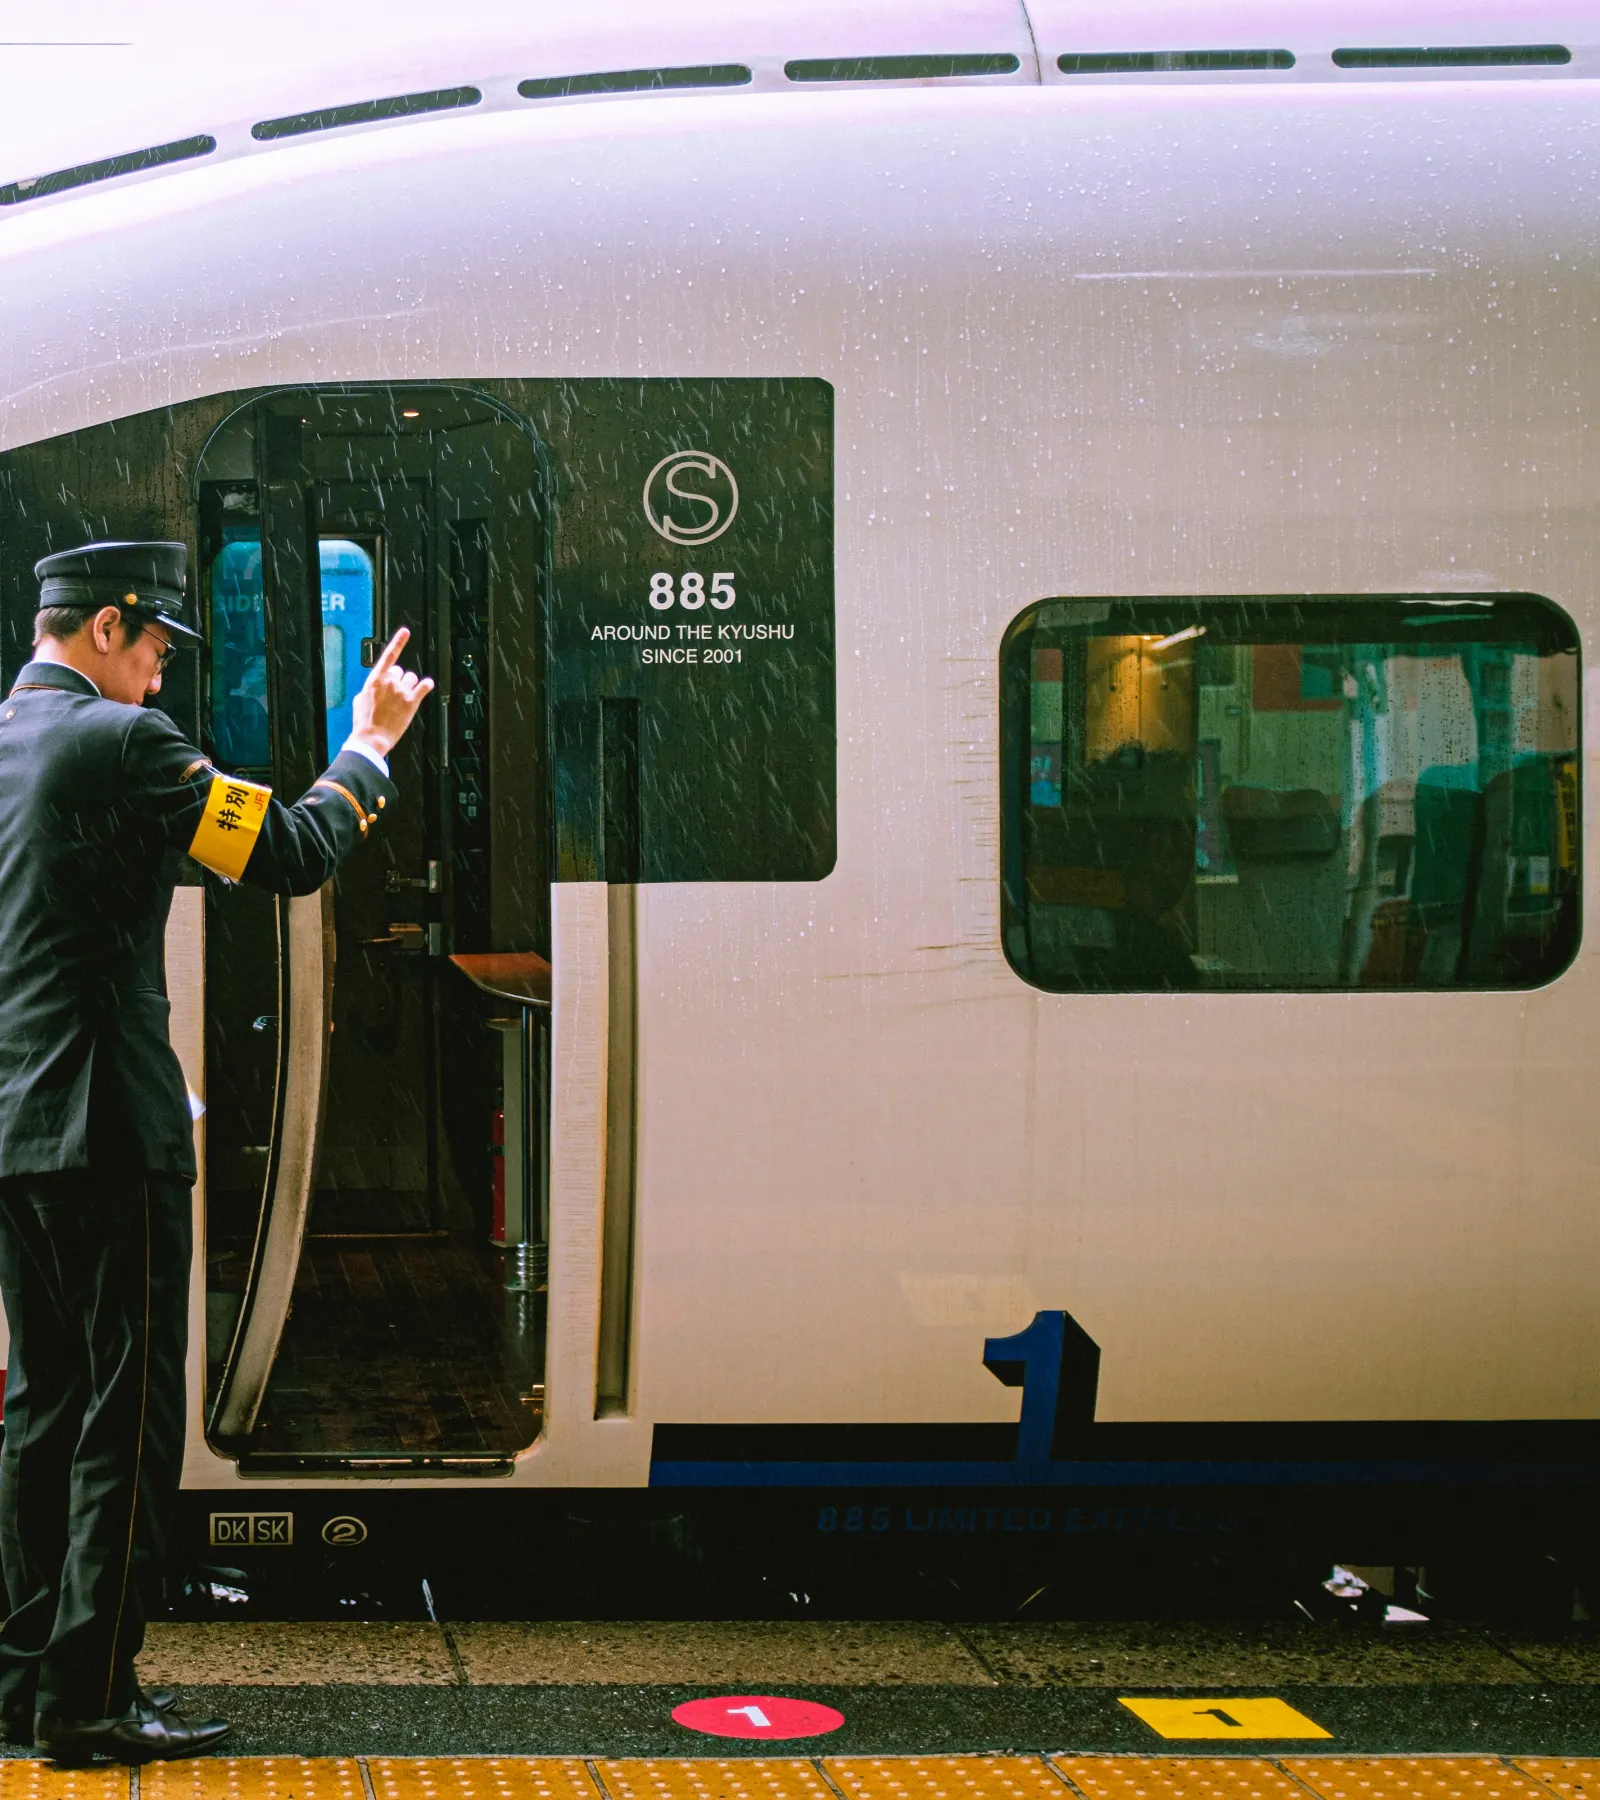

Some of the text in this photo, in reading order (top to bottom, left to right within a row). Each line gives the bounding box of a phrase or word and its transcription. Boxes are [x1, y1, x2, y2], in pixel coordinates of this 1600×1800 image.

[648, 572, 736, 610] 885
[590, 624, 795, 641] AROUND THE KYUSHU
[641, 648, 742, 664] SINCE 2001
[215, 785, 250, 832] 特別
[983, 1310, 1101, 1462] 1
[217, 1519, 285, 1541] DK SK
[816, 1506, 889, 1532] 885
[726, 1705, 771, 1727] 1
[1192, 1708, 1243, 1727] 1
